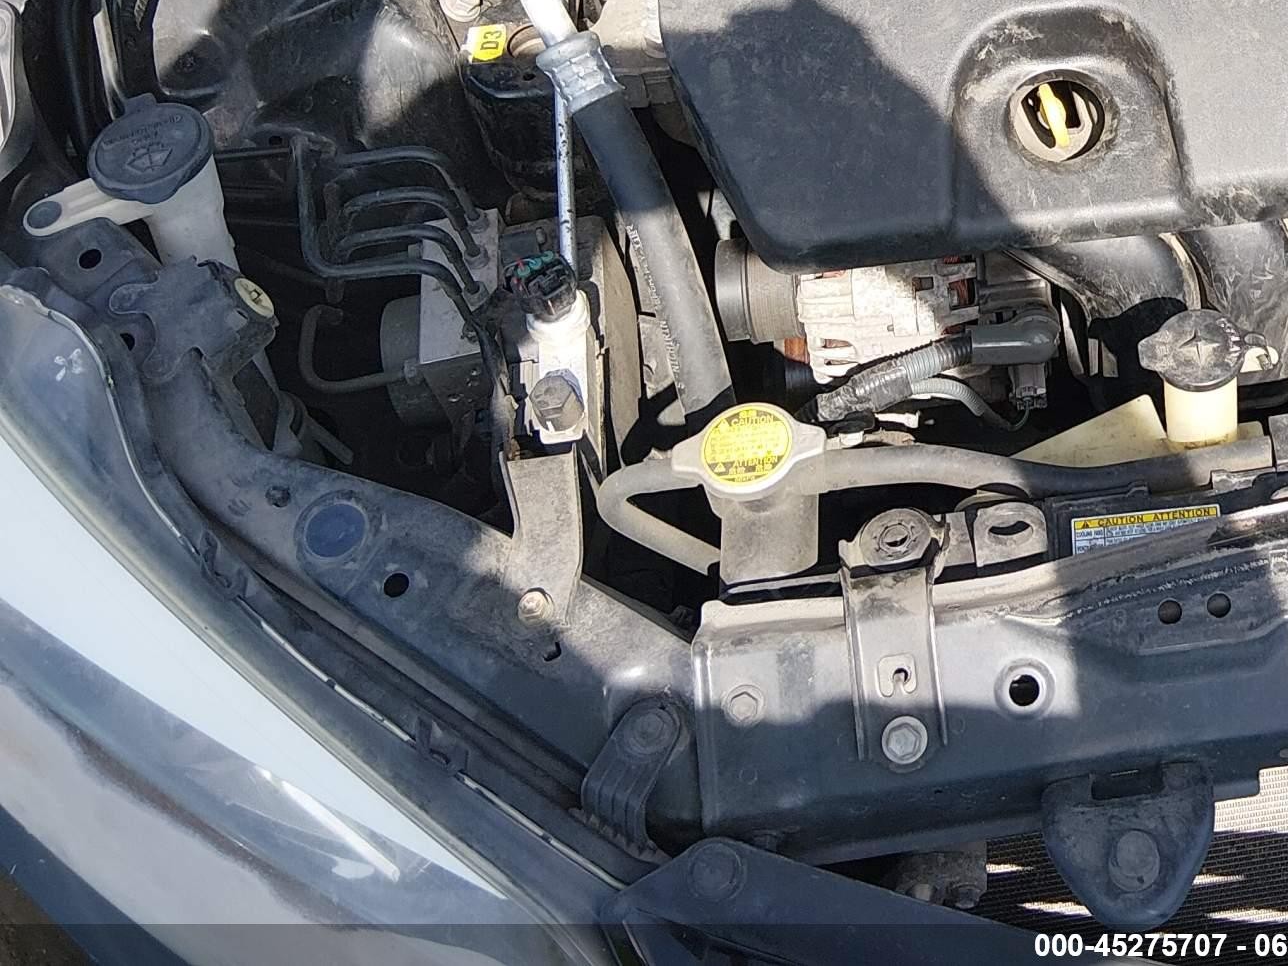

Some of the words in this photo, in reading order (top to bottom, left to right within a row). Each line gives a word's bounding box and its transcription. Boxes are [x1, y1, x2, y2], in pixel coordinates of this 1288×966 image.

[480, 30, 502, 51] D3
[731, 414, 774, 427] CAUTION
[732, 455, 778, 468] ATTENTION
[1097, 514, 1145, 528] CAUTION
[1152, 507, 1211, 522] ATTENTION
